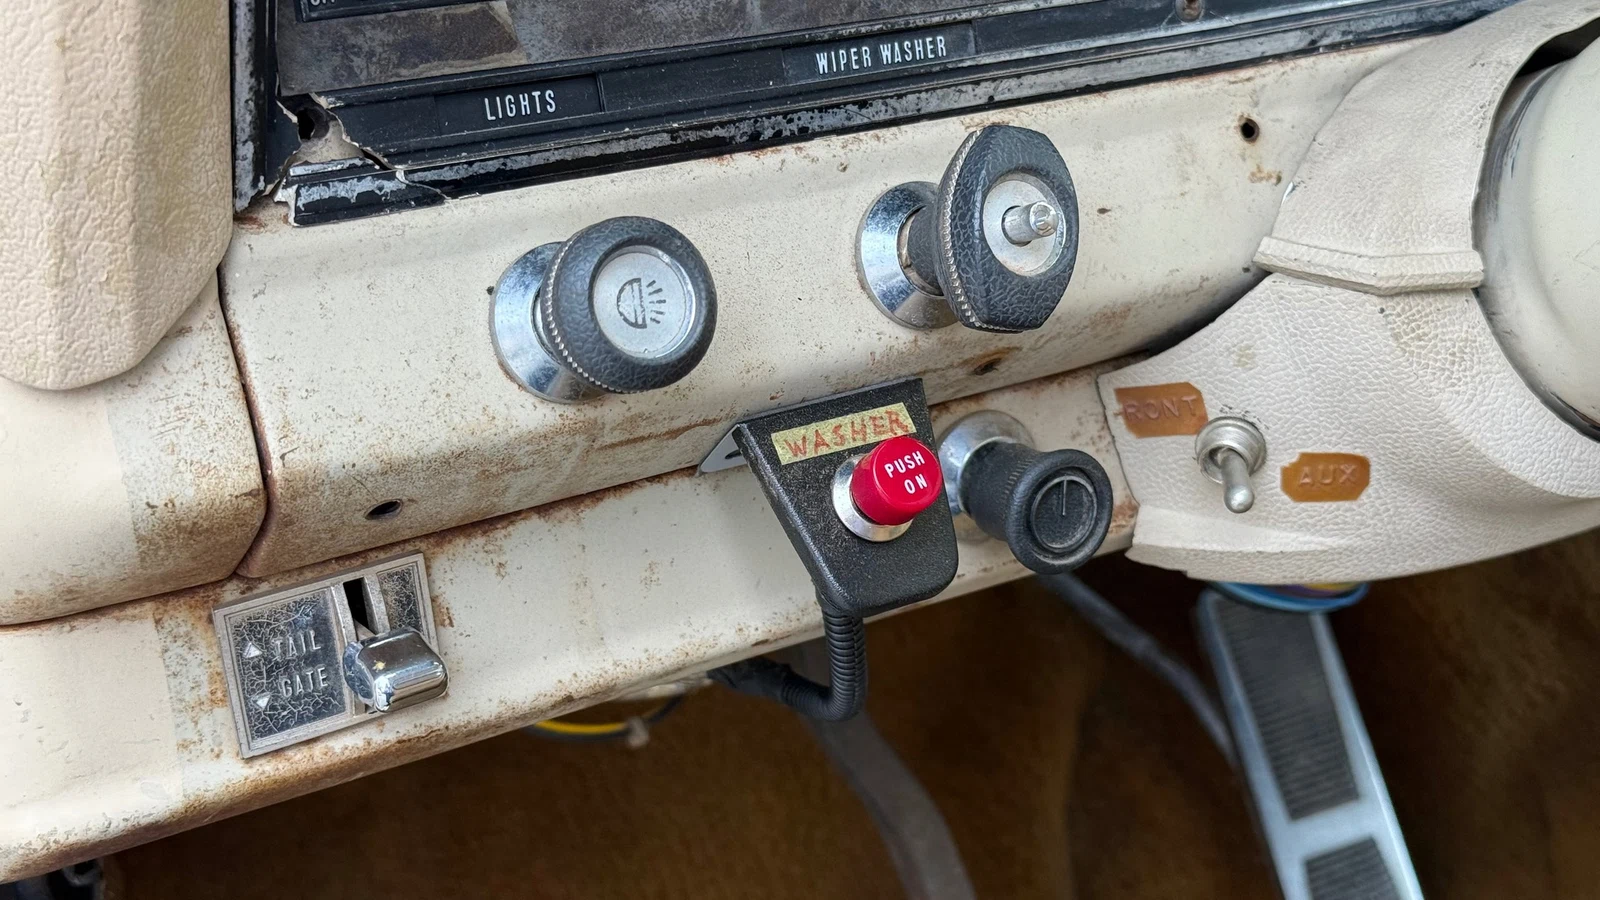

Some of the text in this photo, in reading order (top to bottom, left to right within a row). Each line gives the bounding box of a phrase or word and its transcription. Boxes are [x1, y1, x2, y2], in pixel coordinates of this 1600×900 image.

[815, 35, 947, 75] WIPER WASHER
[484, 89, 556, 121] LIGHTS
[1113, 395, 1198, 423] RONT
[784, 409, 909, 458] WASHER
[884, 450, 926, 478] PUSH
[1299, 463, 1358, 487] AUX
[904, 473, 928, 495] ON
[271, 629, 321, 658] TAIL
[280, 666, 329, 698] GATE
